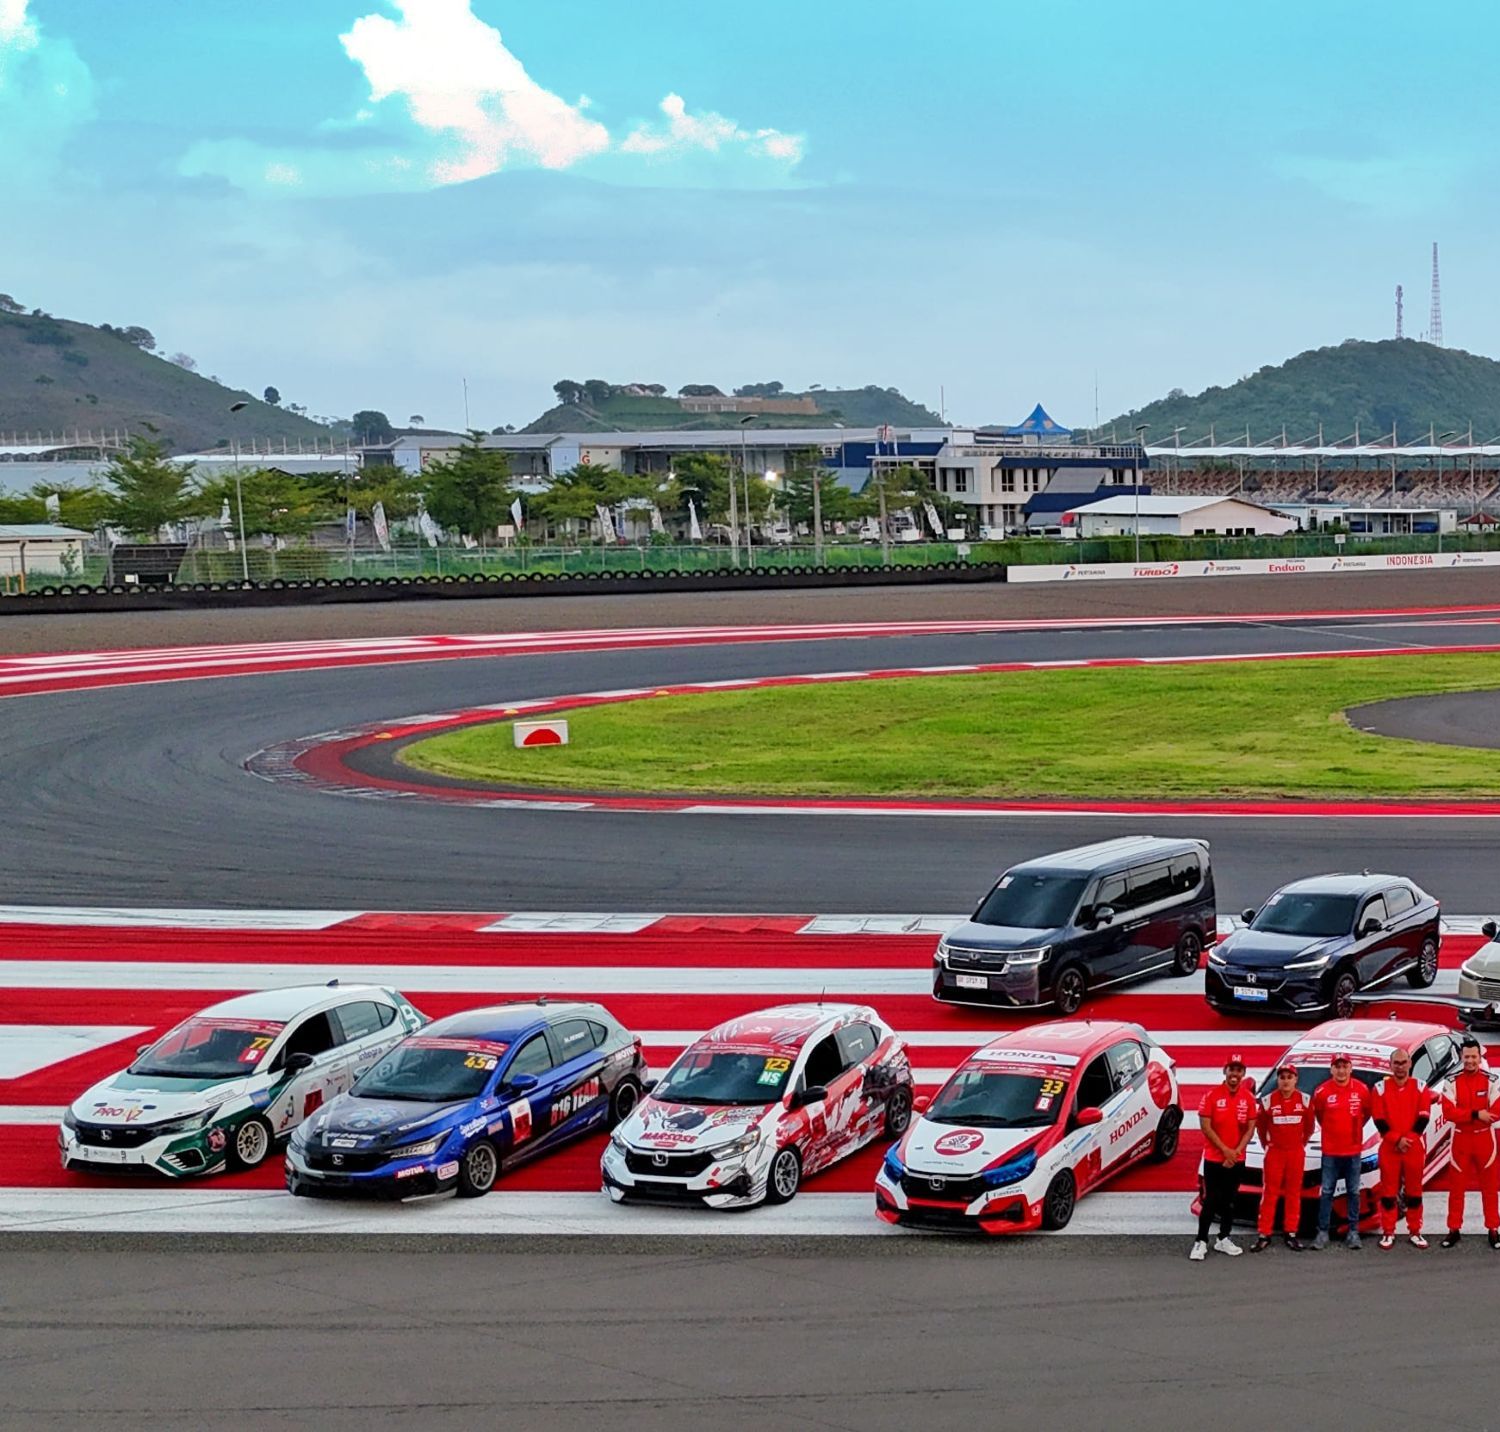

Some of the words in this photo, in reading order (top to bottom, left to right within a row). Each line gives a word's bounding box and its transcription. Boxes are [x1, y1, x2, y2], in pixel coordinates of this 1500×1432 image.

[582, 455, 590, 464] G
[1387, 555, 1433, 566] INDONESIA
[1268, 564, 1305, 573] Enduro
[250, 1037, 273, 1049] 77
[1312, 1043, 1380, 1053] HONDA
[990, 1050, 1058, 1062] HONDA
[464, 1056, 486, 1069] 45
[766, 1058, 791, 1072] 123
[760, 1072, 783, 1084] NS
[1040, 1079, 1064, 1094] 33
[572, 1076, 600, 1112] TEAM
[92, 1107, 122, 1116] PRO
[1109, 1106, 1149, 1145] HONDA
[638, 1132, 699, 1144] MARSOSE
[397, 1165, 424, 1178] MOTUL
